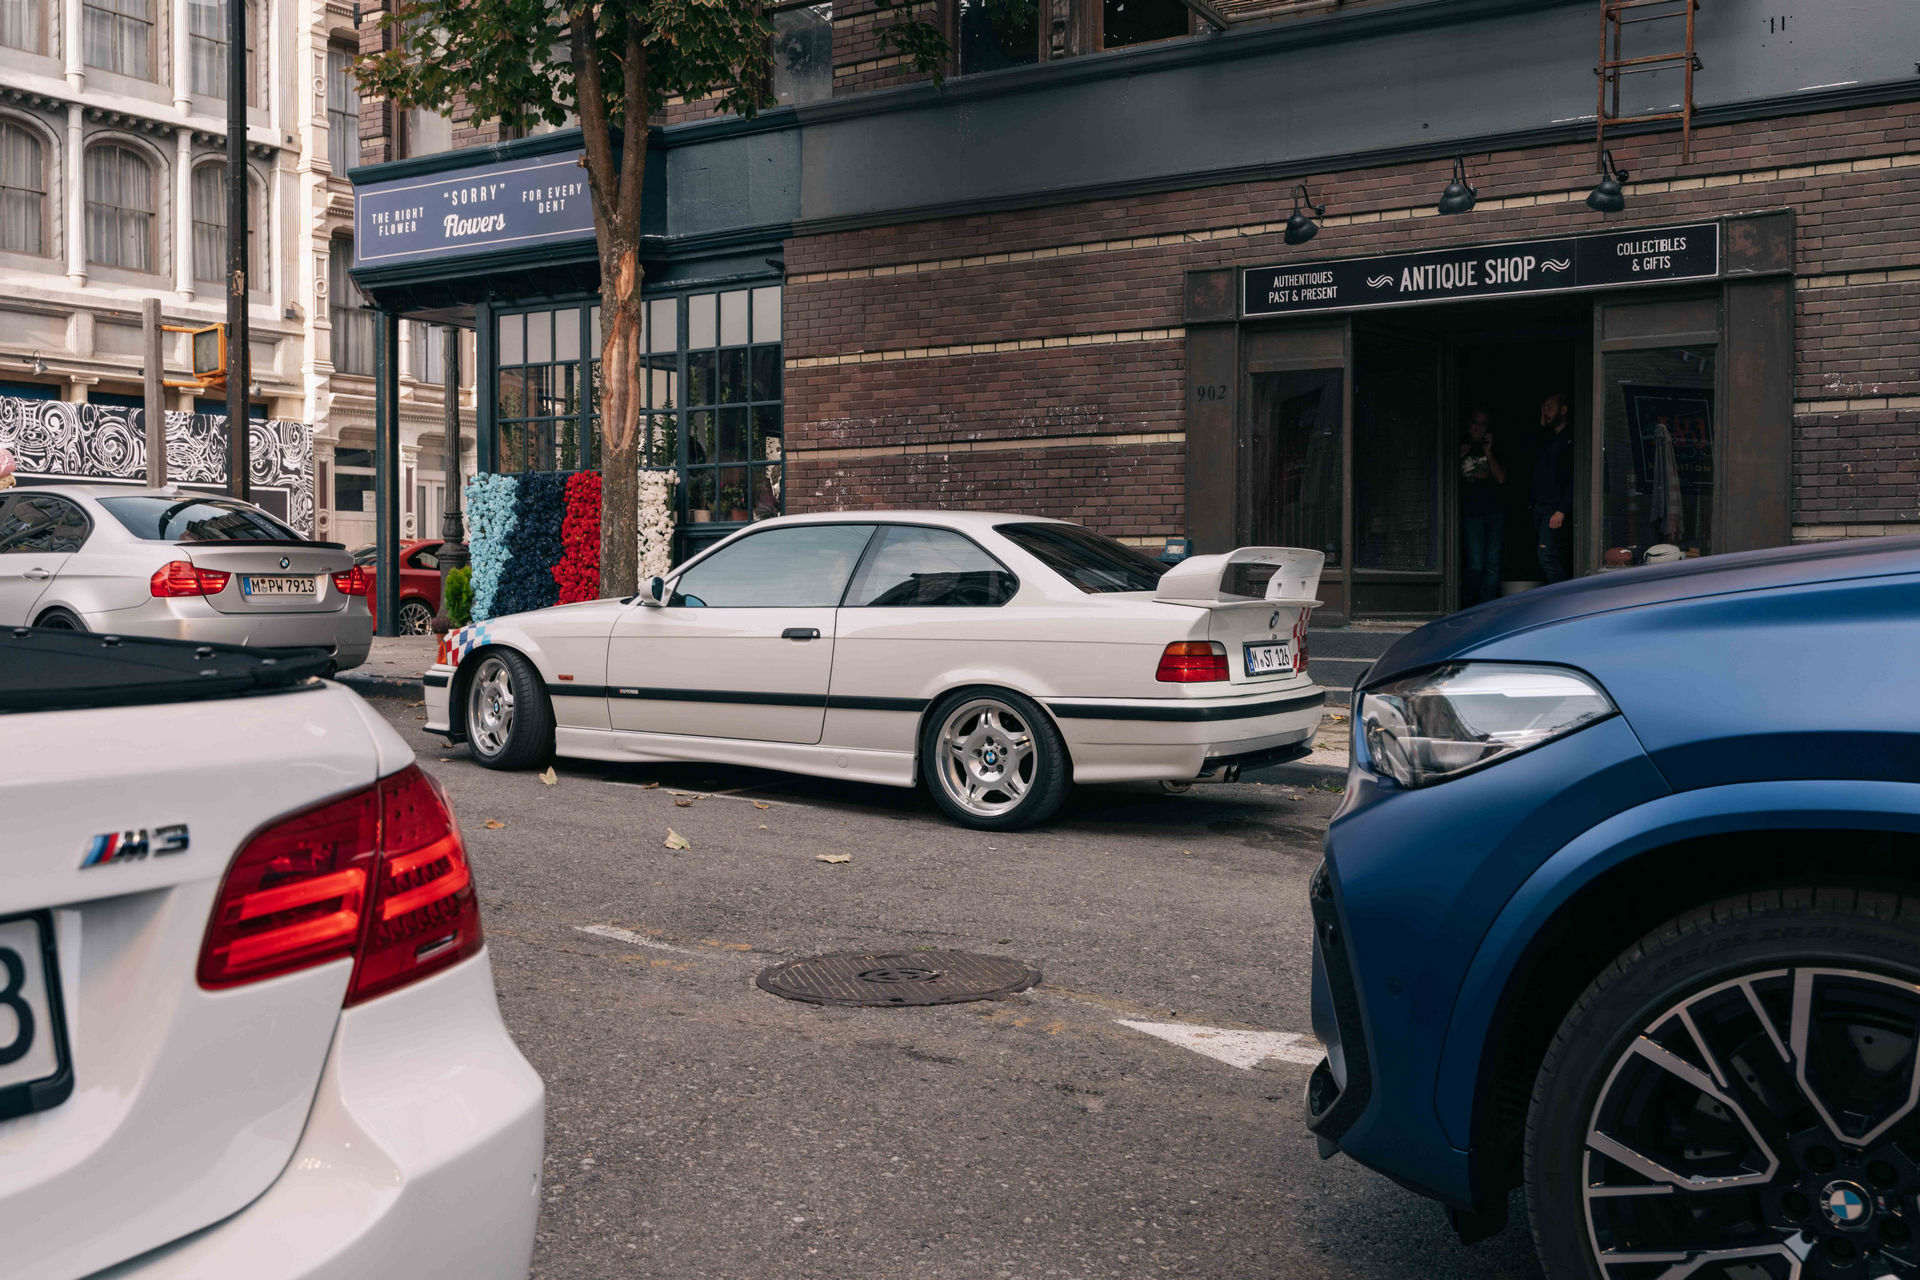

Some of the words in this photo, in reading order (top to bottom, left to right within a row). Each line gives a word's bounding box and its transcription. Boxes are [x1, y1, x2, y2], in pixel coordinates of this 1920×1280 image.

[522, 189, 541, 203] FOR
[548, 183, 582, 199] EVERY
[538, 199, 565, 214] DENT
[372, 212, 389, 225] THE
[394, 207, 424, 222] RIGHT
[379, 221, 417, 237] FLOWER
[443, 213, 506, 238] Flowers
[1616, 237, 1686, 256] COLLECTIBLES
[1632, 258, 1641, 272] &
[1643, 255, 1671, 271] GIFTS
[1273, 271, 1333, 288] AUTHENTIQUES
[1400, 260, 1478, 292] ANTIQUE
[1484, 255, 1536, 285] SHOP
[1268, 290, 1290, 304] PAST
[1292, 291, 1299, 302] &
[1301, 286, 1338, 301] PRESENT
[1197, 385, 1227, 402] 902
[251, 579, 261, 592] M
[268, 579, 283, 592] PW
[286, 579, 315, 593] 7913
[1263, 649, 1274, 667] ST
[1275, 648, 1290, 666] 126
